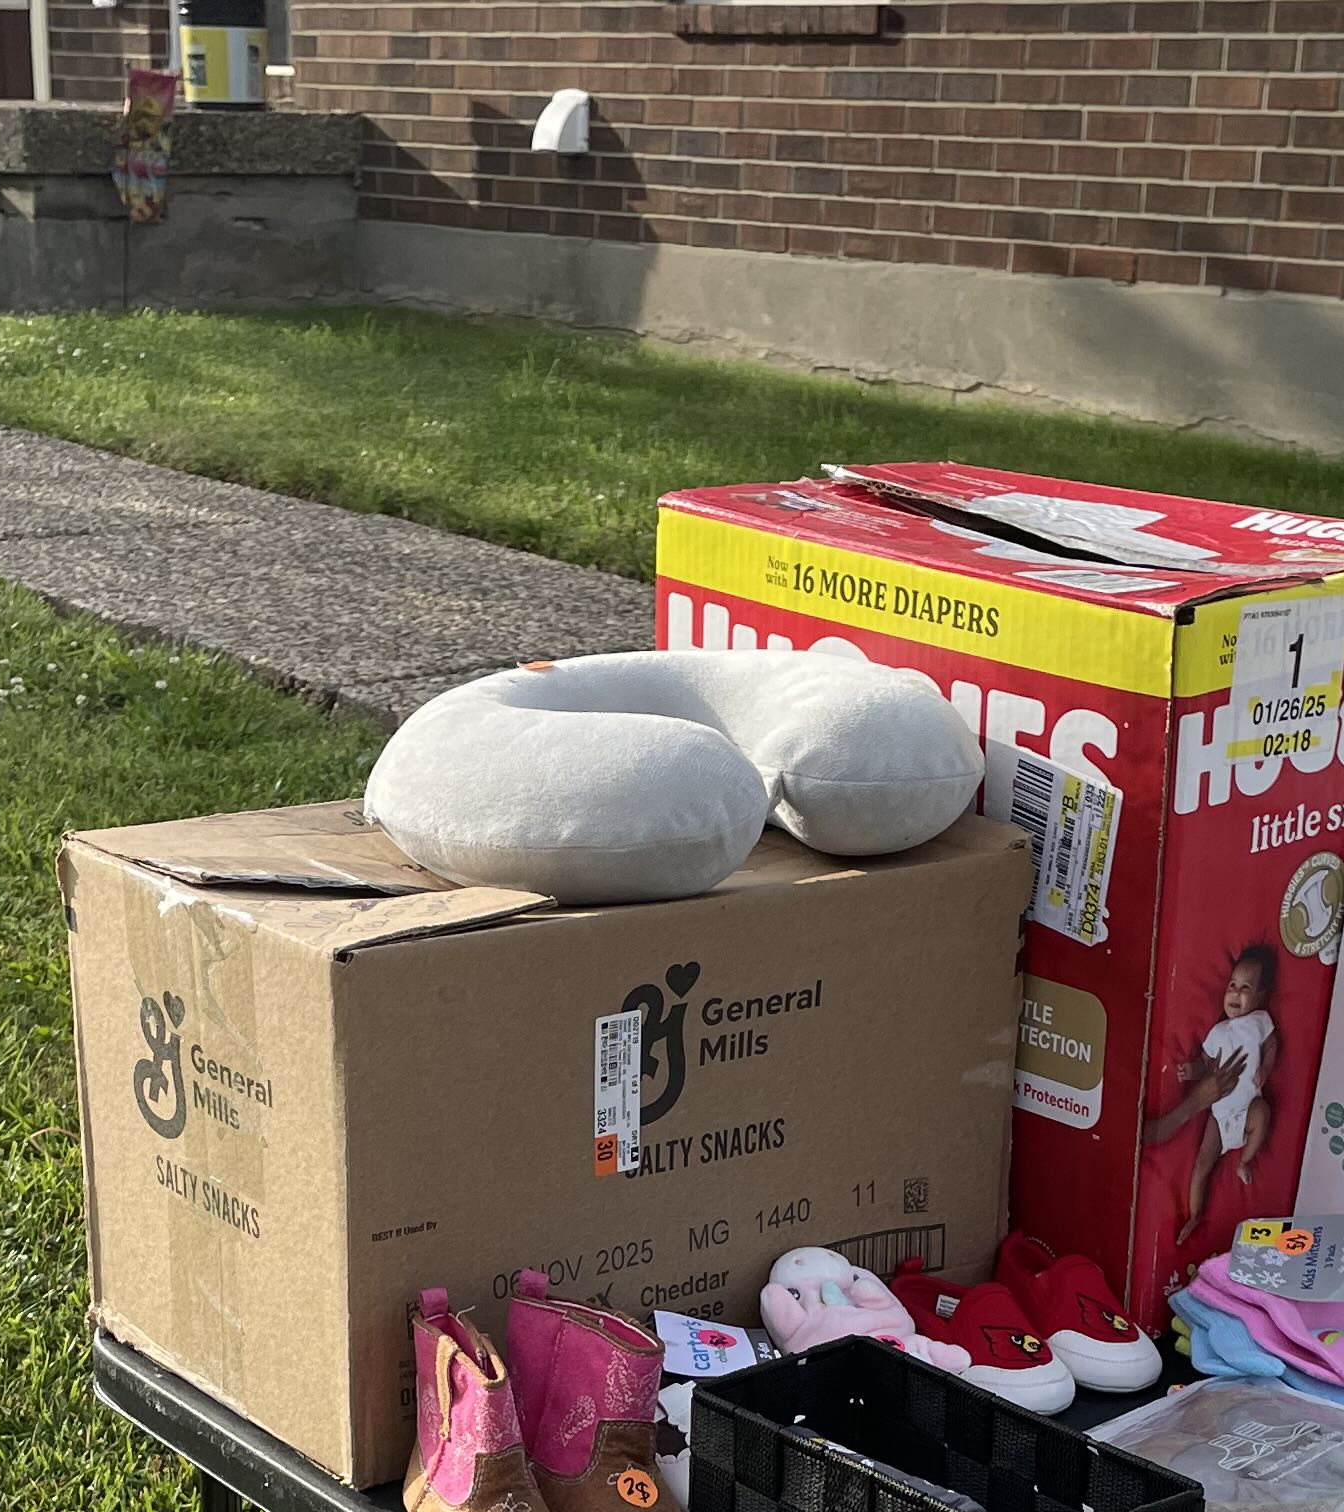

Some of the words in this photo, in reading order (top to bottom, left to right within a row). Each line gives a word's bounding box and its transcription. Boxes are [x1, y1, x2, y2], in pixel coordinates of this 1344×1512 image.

[765, 571, 788, 588] with
[767, 555, 789, 572] Now
[793, 562, 814, 593] 16
[819, 570, 887, 612] MORE
[893, 586, 1000, 638] DIAPERS
[1222, 634, 1238, 649] No
[1289, 633, 1305, 689] 1
[1253, 694, 1326, 725] 01/26/25
[1263, 728, 1311, 758] 02:18
[1250, 811, 1321, 854] little
[1080, 883, 1102, 935] D0374
[701, 979, 823, 1027] General
[699, 1028, 769, 1067] Mills
[191, 1044, 273, 1108] General
[193, 1080, 241, 1130] Mills
[1023, 1081, 1090, 1118] Protection
[597, 1109, 607, 1135] 3324
[597, 1139, 614, 1162] 30
[625, 1137, 693, 1179] ALTY
[700, 1118, 785, 1165] SNACKS
[156, 1154, 198, 1203] SALTY
[202, 1184, 261, 1239] SNACKS
[371, 1229, 394, 1242] BEST
[404, 1223, 425, 1236] Used
[531, 1254, 584, 1290] OV
[596, 1240, 654, 1275] 2025
[688, 1219, 730, 1253] MG
[755, 1197, 812, 1234] 1440
[852, 1180, 877, 1208] 11
[1305, 1225, 1323, 1267] Mittens
[1325, 1243, 1337, 1262] Pack
[641, 1268, 730, 1308] Cheddar
[1301, 1268, 1317, 1290] Kids
[681, 1320, 711, 1371] carter's
[623, 1477, 650, 1504] 2$
